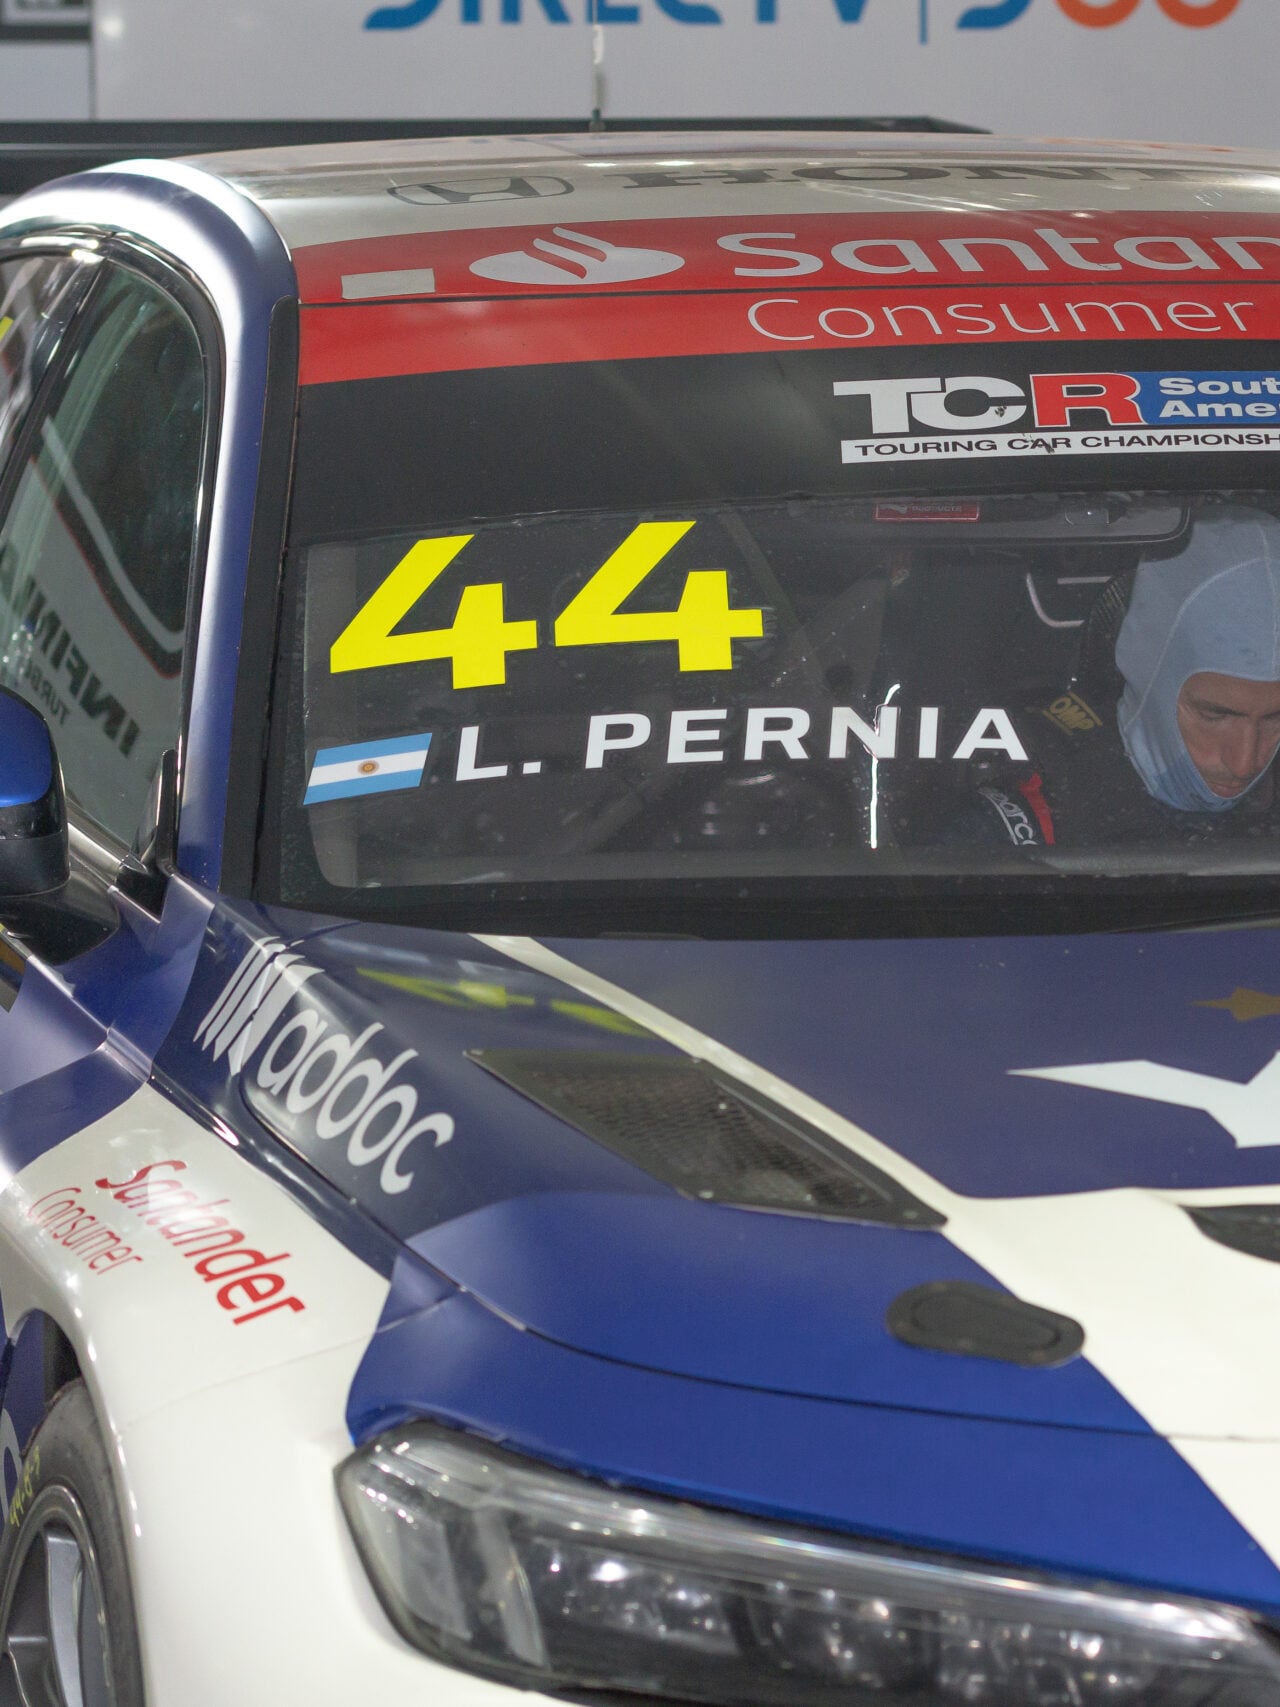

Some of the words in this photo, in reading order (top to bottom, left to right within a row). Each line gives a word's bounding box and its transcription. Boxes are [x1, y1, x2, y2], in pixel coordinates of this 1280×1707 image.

[747, 297, 1254, 342] Consumer
[833, 372, 1146, 434] TCR
[855, 439, 997, 458] TOURING
[1006, 436, 1073, 452] CAR
[330, 520, 764, 690] 44
[456, 726, 541, 781] L.
[585, 707, 1029, 769] PERNIA
[1050, 696, 1095, 730] OMP
[28, 1187, 143, 1276] Consumer
[94, 1159, 306, 1326] Santander
